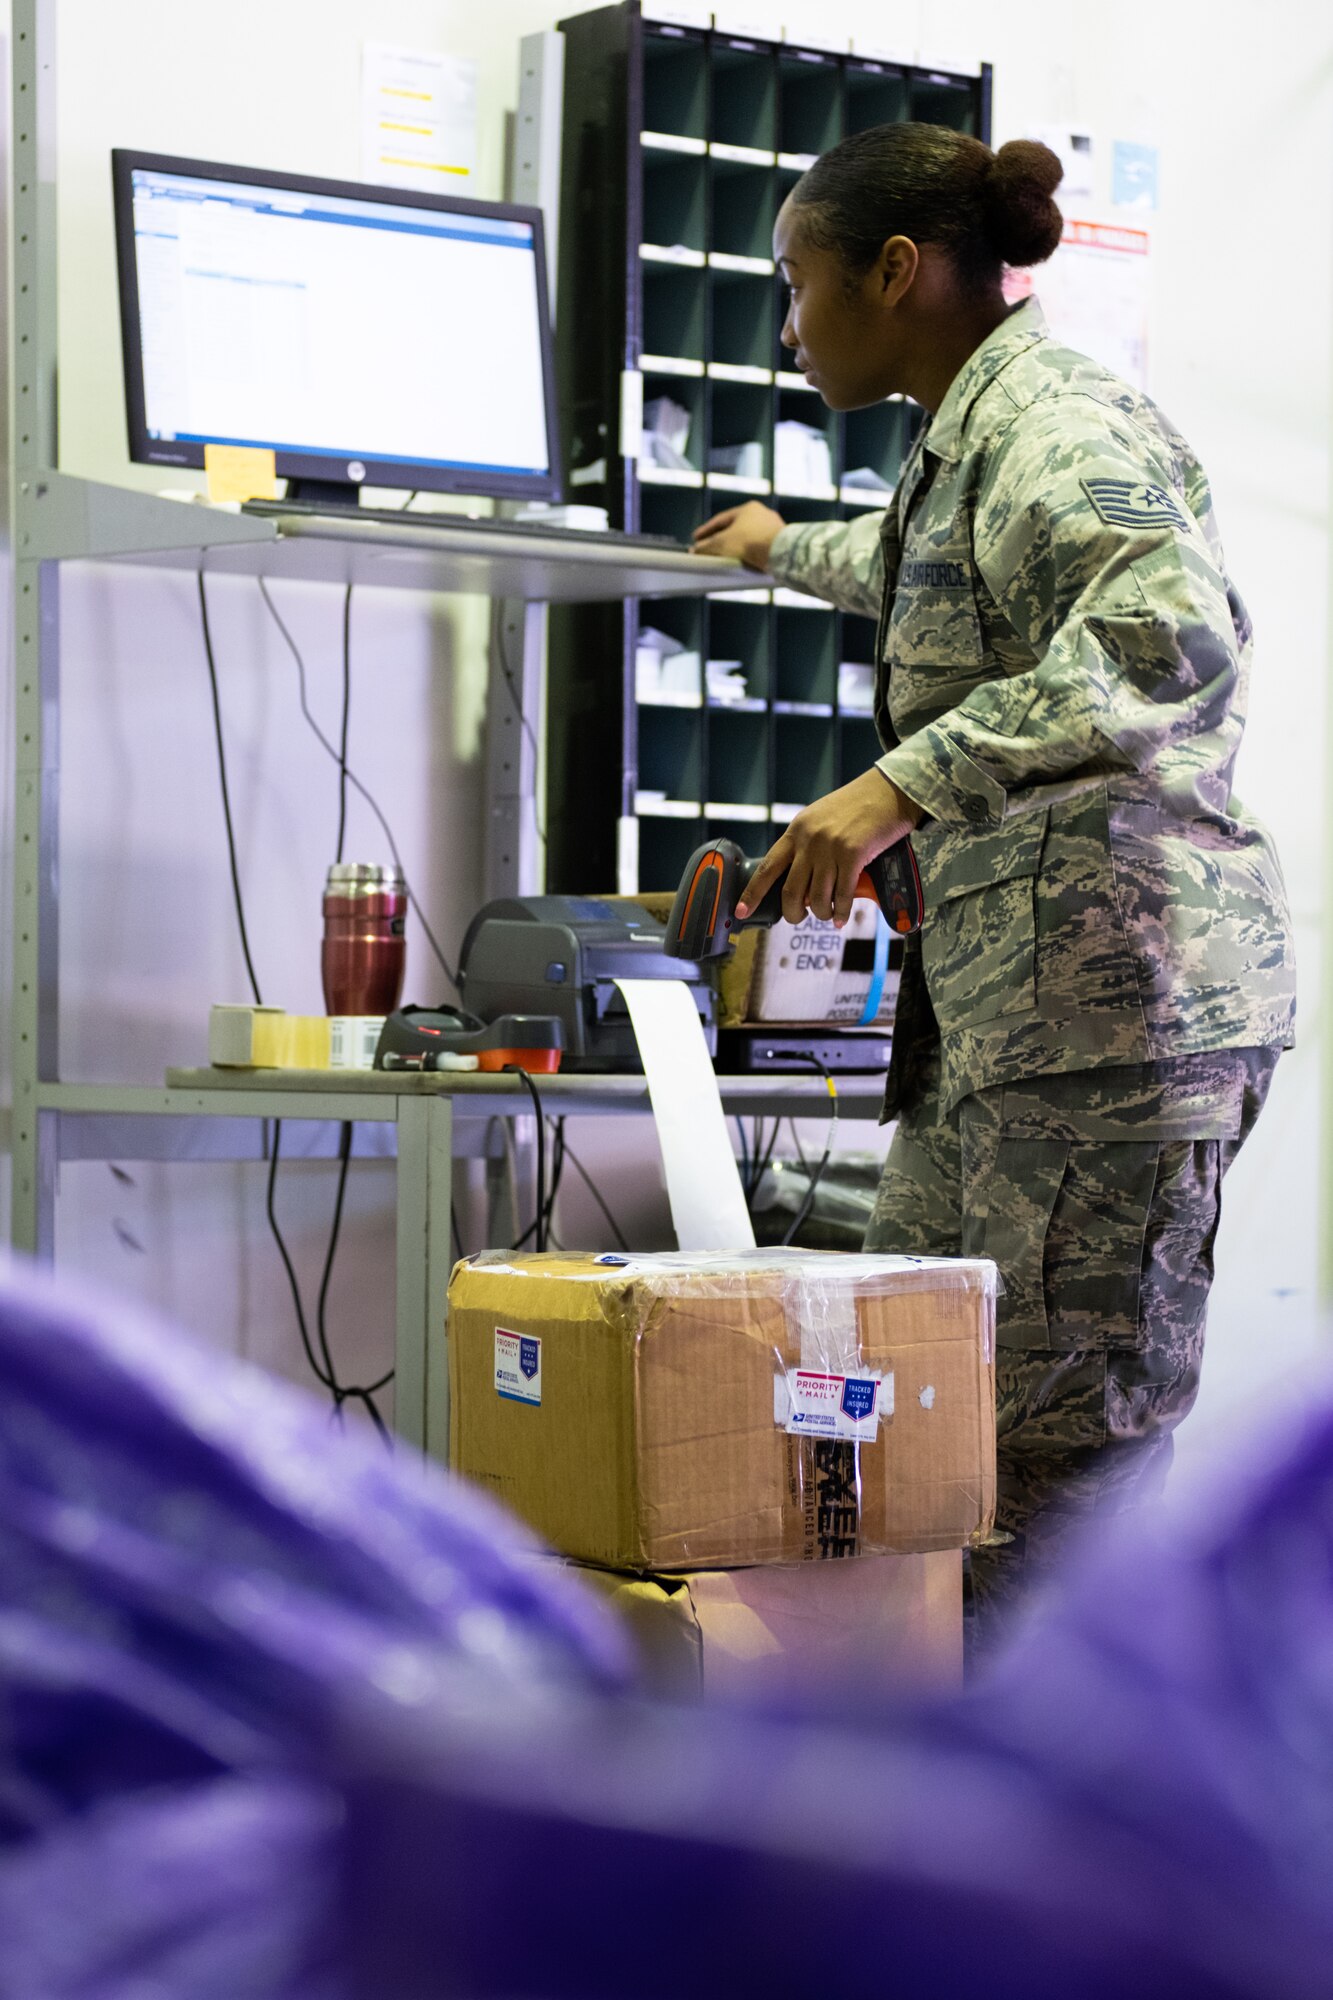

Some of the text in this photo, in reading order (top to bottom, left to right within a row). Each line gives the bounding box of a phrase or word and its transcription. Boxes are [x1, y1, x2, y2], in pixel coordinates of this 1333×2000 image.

[925, 563, 967, 587] FORCE
[794, 916, 837, 931] LABE
[790, 935, 841, 950] OTHER
[796, 954, 829, 970] END
[496, 1338, 519, 1350] PRIORITY
[501, 1348, 513, 1357] MAIL
[796, 1380, 840, 1392] PRIORITY
[848, 1385, 871, 1394] TRACKED
[805, 1390, 828, 1399] MAIL
[846, 1400, 869, 1409] INSURED
[804, 1480, 814, 1536] ADVANCED
